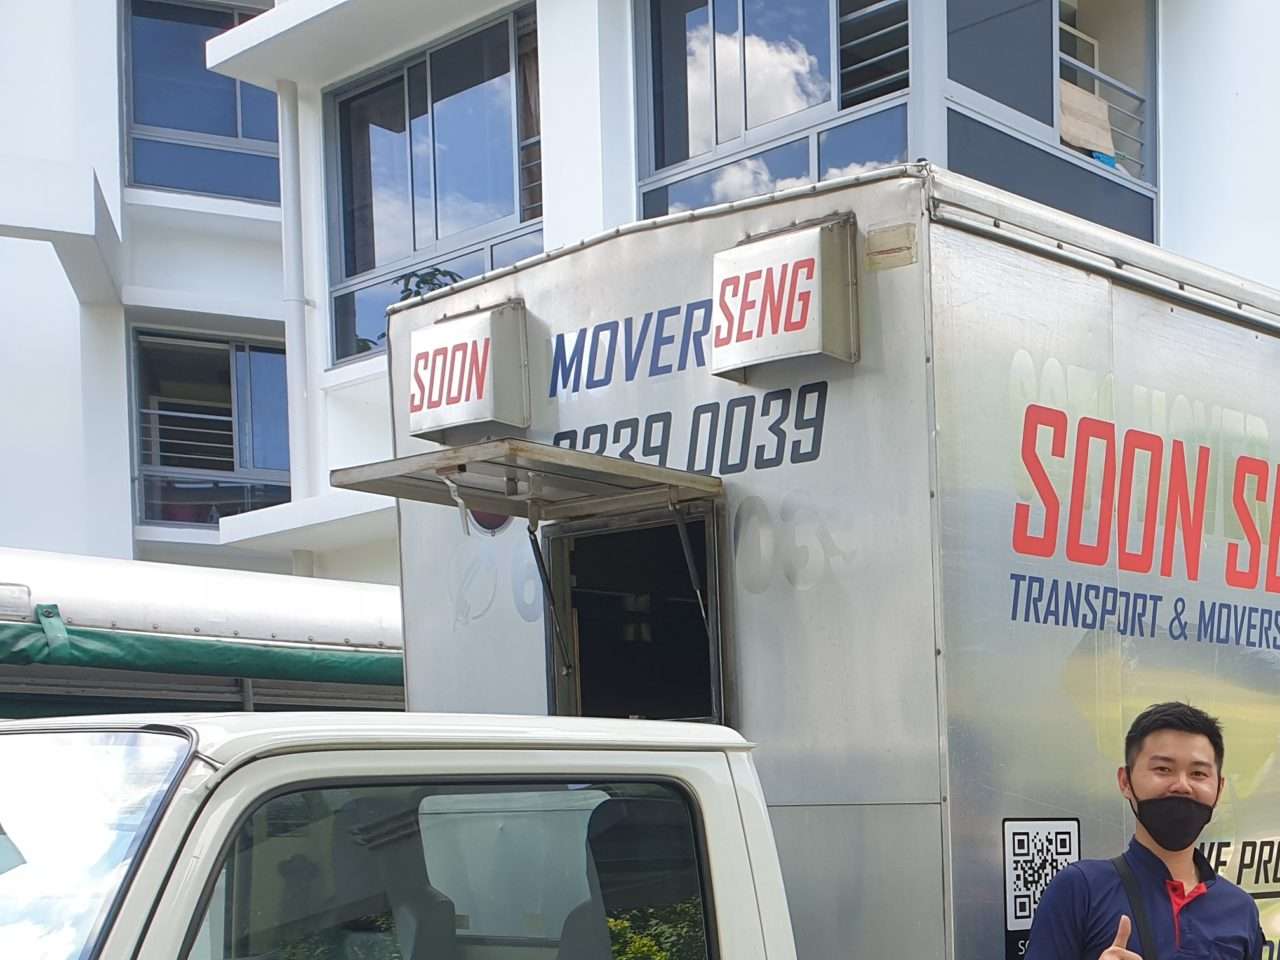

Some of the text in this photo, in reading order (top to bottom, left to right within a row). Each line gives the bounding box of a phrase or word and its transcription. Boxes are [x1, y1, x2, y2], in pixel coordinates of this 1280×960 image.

[548, 298, 714, 398] MOVER
[714, 257, 816, 348] SENG
[410, 337, 490, 413] SOON
[552, 380, 829, 476] 39 0039
[1012, 403, 1211, 582] SOON
[1010, 573, 1163, 639] TRANSPORT
[1168, 597, 1188, 641] &
